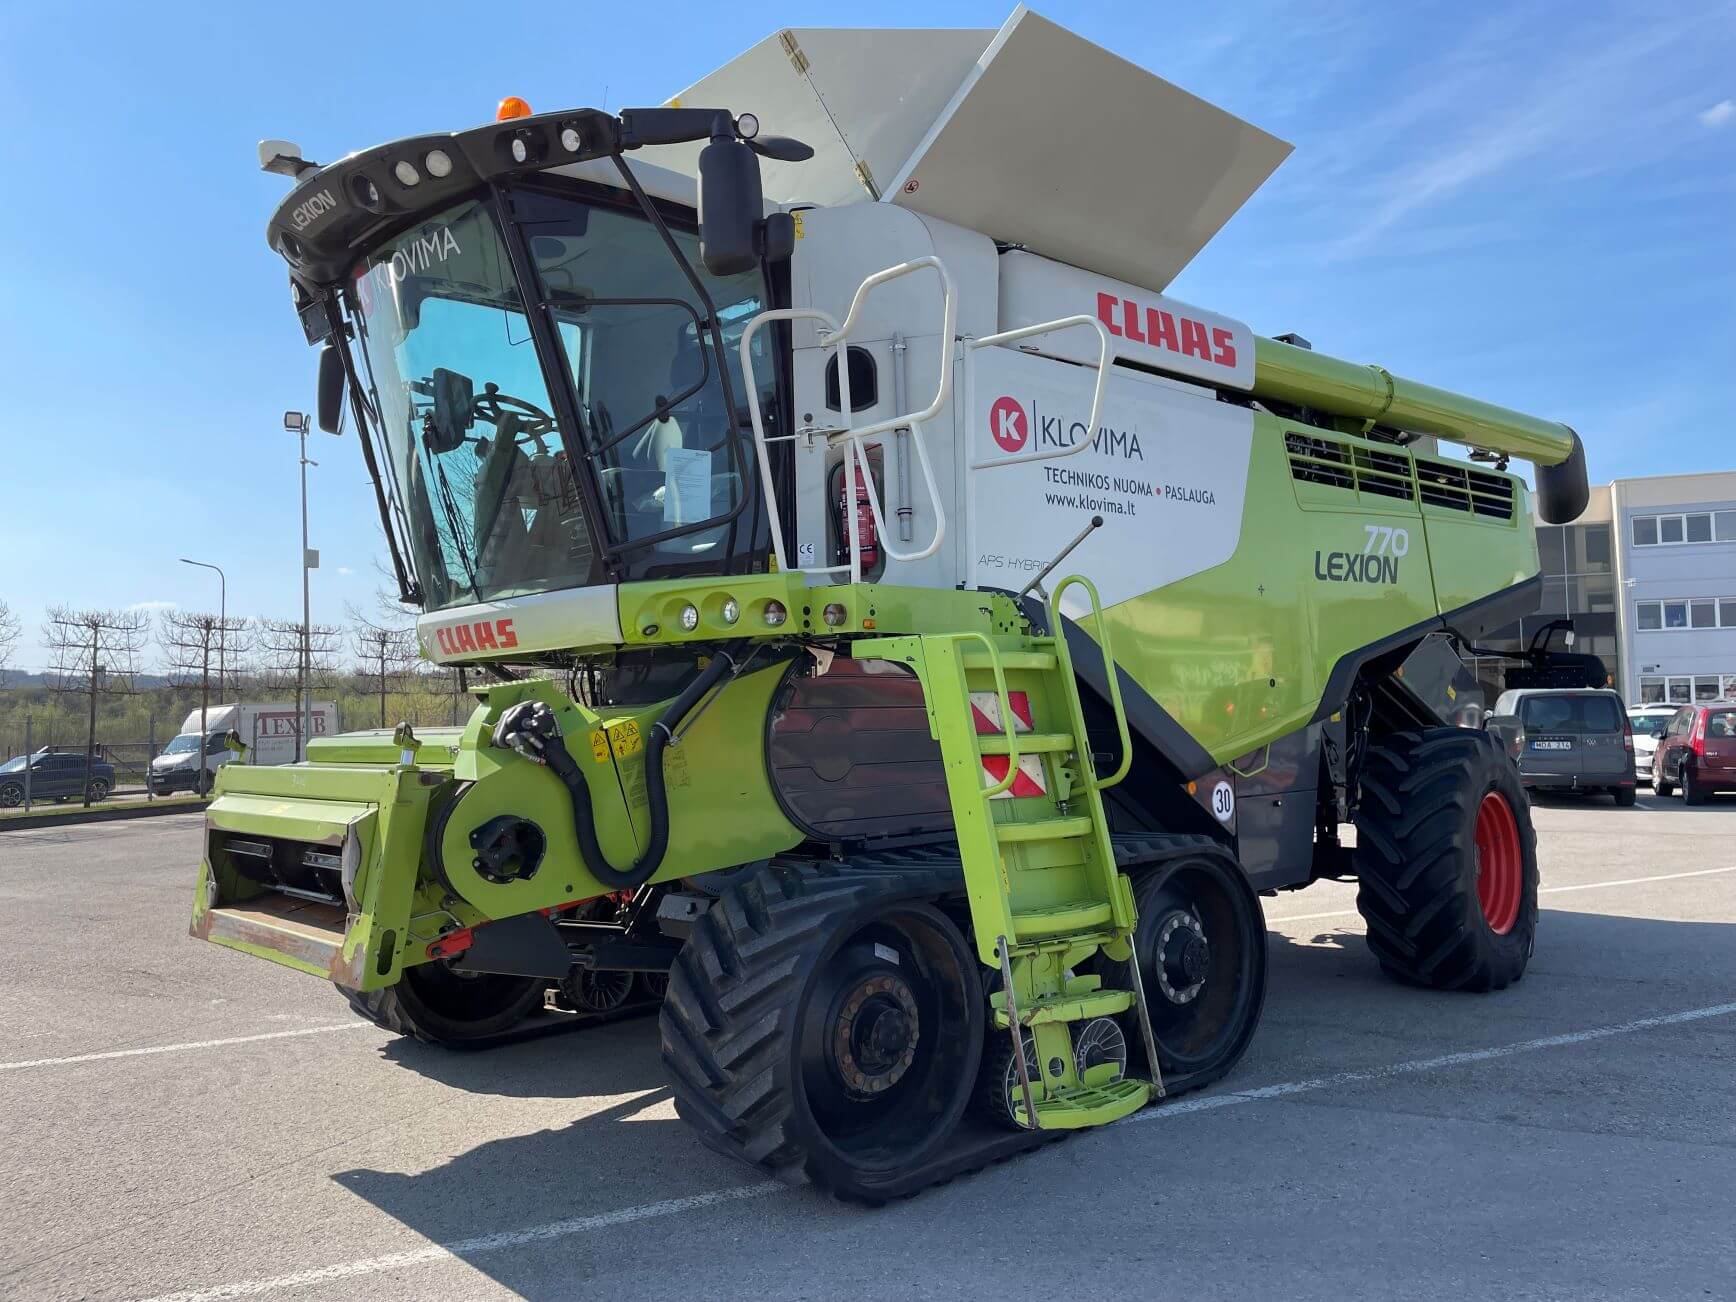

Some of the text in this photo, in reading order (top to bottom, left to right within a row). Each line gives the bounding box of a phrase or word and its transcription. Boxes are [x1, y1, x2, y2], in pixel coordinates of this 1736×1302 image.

[292, 189, 337, 232] LEXION
[374, 226, 462, 294] KLOVIMA
[1097, 292, 1237, 369] CLAAS
[998, 408, 1144, 461] K KLOVIMA
[1044, 466, 1216, 506] TECHNIKOS NUOMA PASLAUGA
[1045, 493, 1136, 516] www.klovima.lt
[1364, 525, 1409, 557] 770
[978, 554, 1004, 569] APS
[1314, 550, 1399, 584] LEXION
[436, 618, 518, 656] CLAAS
[1216, 788, 1231, 813] 30
